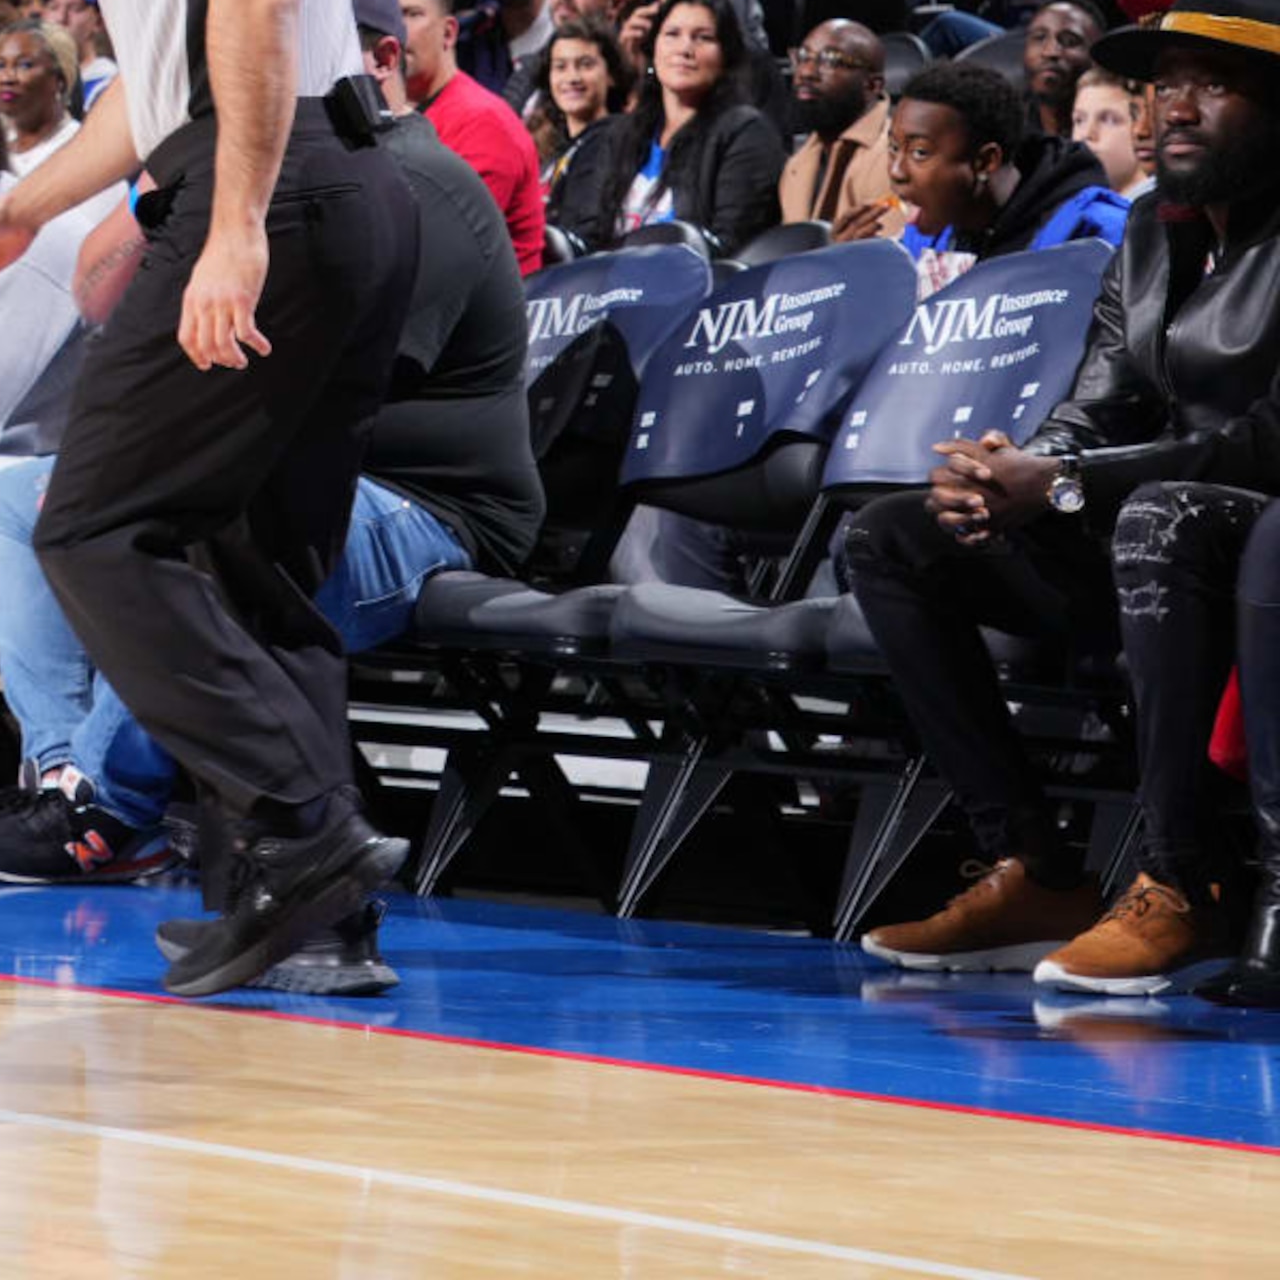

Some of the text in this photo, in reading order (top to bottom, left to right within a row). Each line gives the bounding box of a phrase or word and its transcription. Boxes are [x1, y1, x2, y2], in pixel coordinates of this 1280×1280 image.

[525, 293, 586, 345] JM
[683, 282, 847, 354] NJM Insurance
[772, 310, 815, 334] Group
[897, 288, 1069, 356] NJM Insurance
[993, 314, 1035, 337] Group
[673, 361, 719, 377] AUTO.
[941, 357, 986, 375] HOME.
